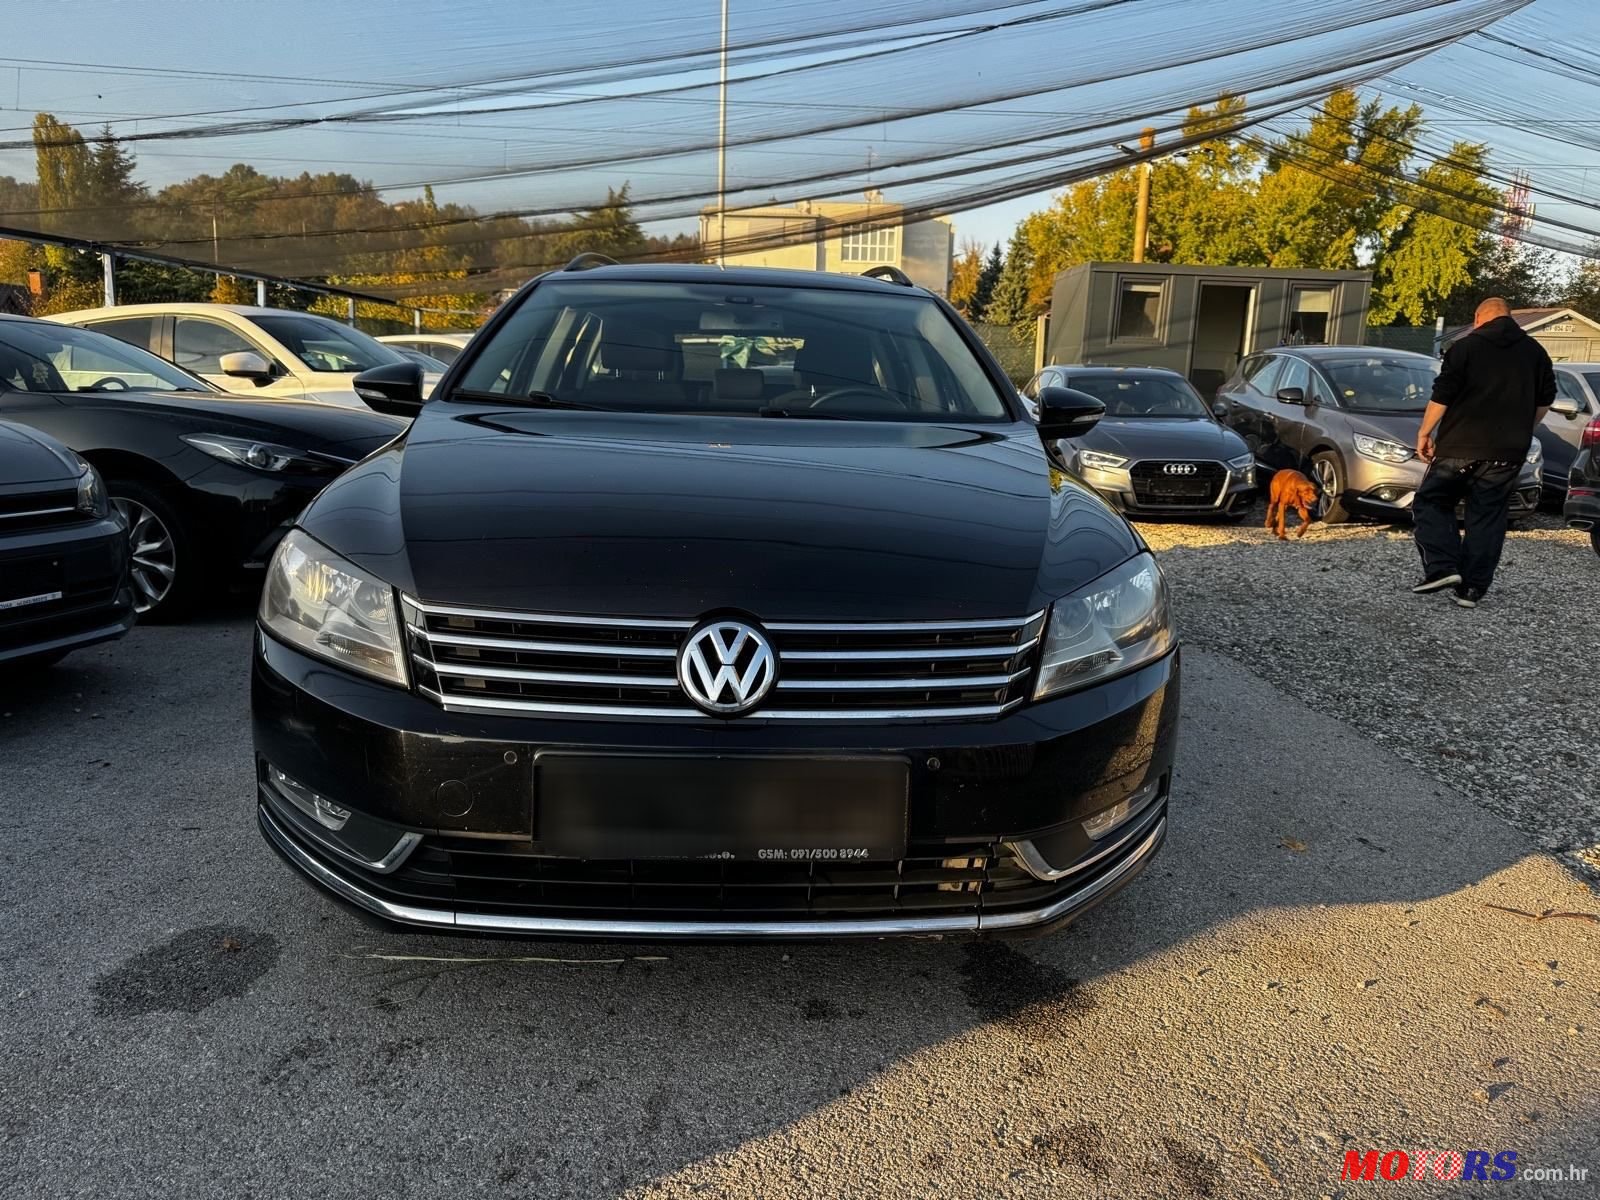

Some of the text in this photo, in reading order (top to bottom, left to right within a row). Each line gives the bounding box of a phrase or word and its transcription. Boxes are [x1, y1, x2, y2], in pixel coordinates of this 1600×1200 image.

[682, 622, 775, 712] VW
[758, 848, 869, 859] GSM: 091/500 8944
